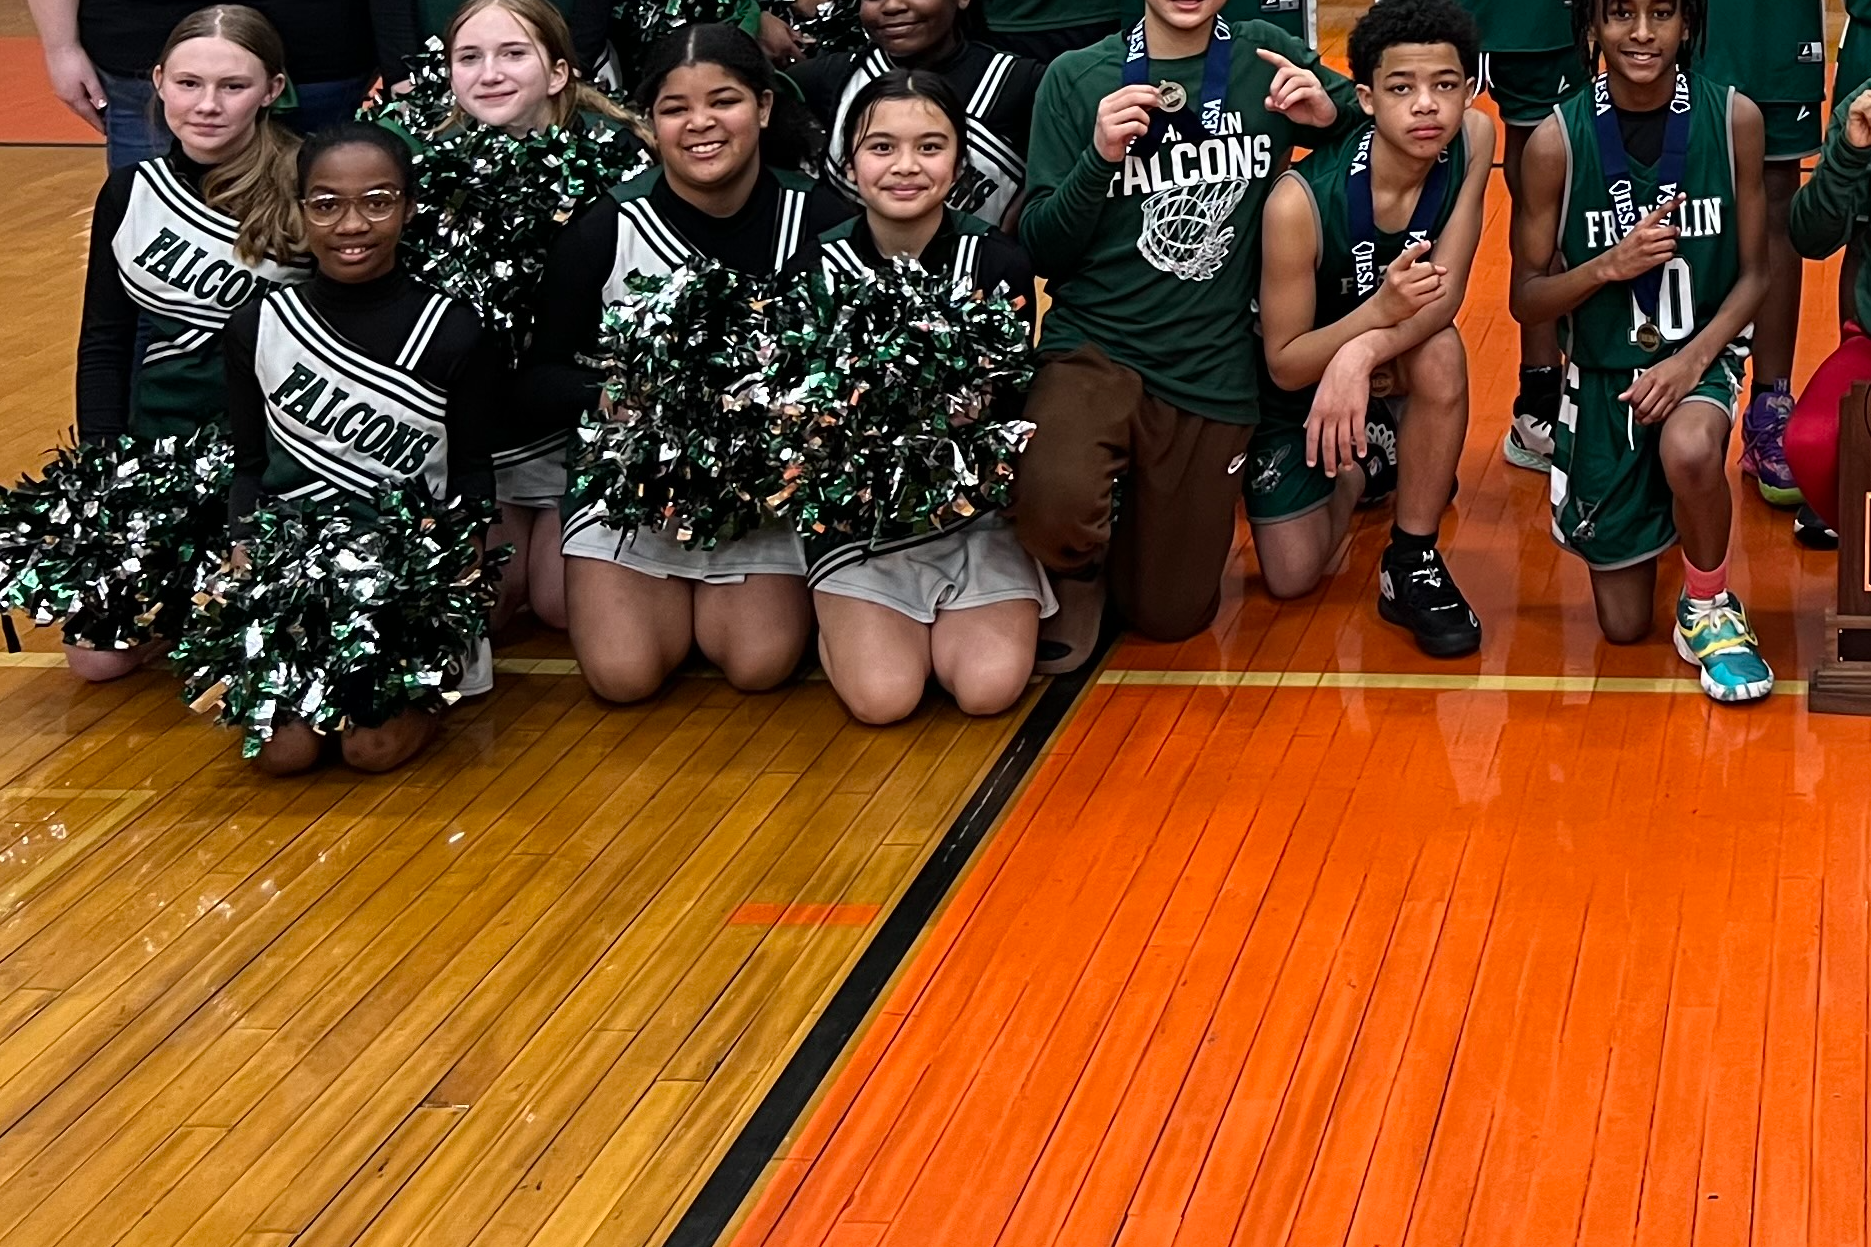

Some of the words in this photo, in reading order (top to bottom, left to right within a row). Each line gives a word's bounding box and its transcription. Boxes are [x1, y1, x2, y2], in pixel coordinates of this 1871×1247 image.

[133, 226, 283, 308] FALCON
[1355, 254, 1374, 296] IESA
[1630, 257, 1695, 342] 0
[268, 361, 438, 475] FALCONS
